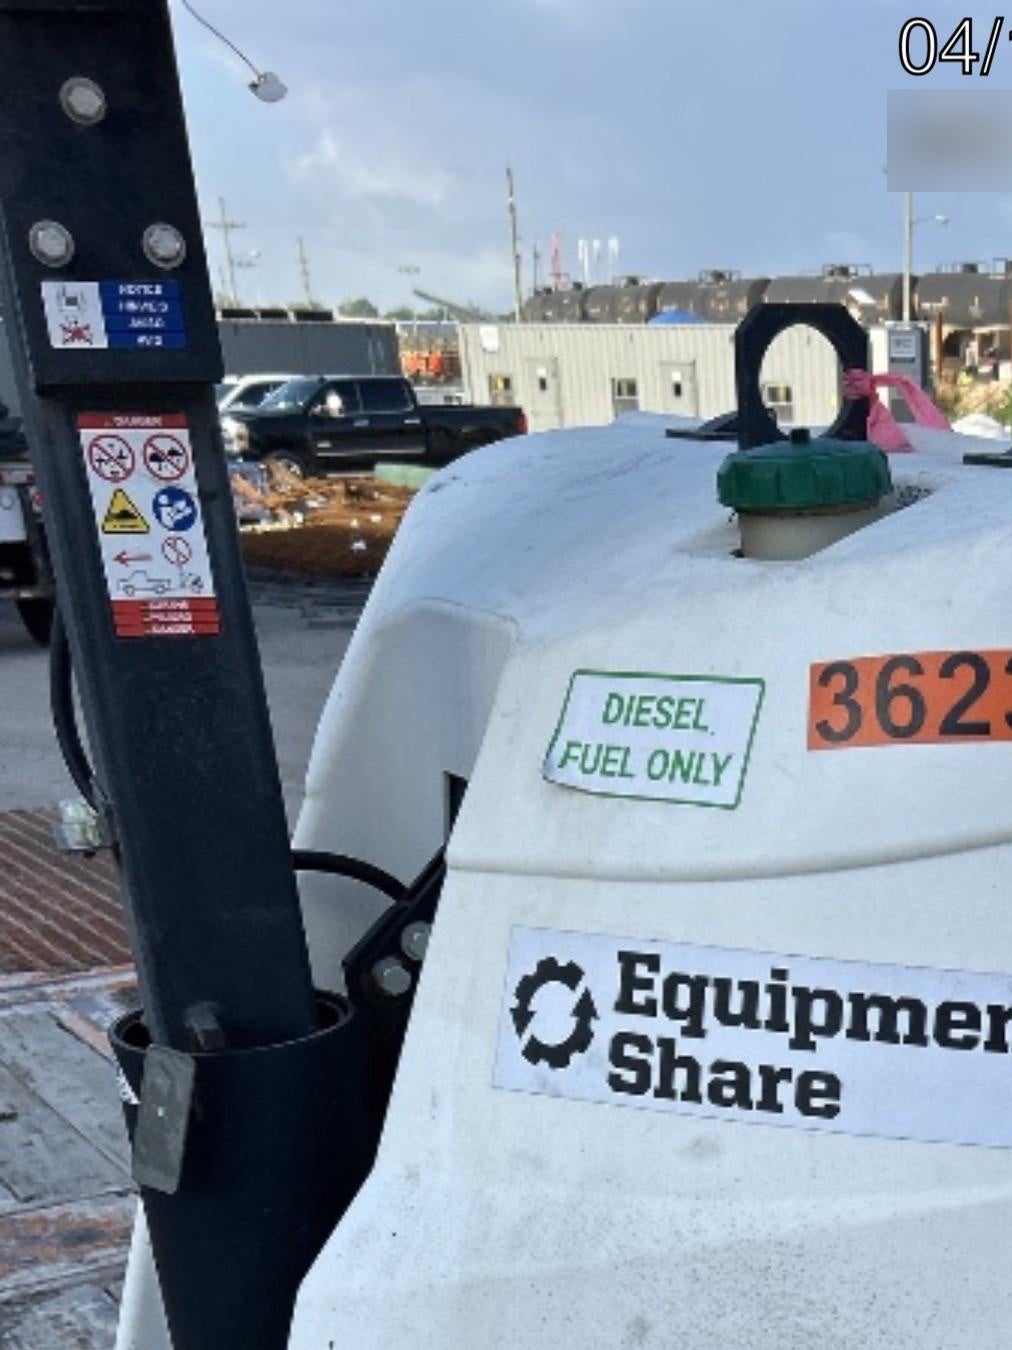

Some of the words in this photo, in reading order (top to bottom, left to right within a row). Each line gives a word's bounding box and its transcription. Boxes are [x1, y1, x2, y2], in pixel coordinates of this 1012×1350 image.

[602, 692, 709, 733] DIESEL
[557, 748, 636, 780] FUEL
[646, 750, 733, 789] ONLY
[606, 1030, 842, 1120] Share
